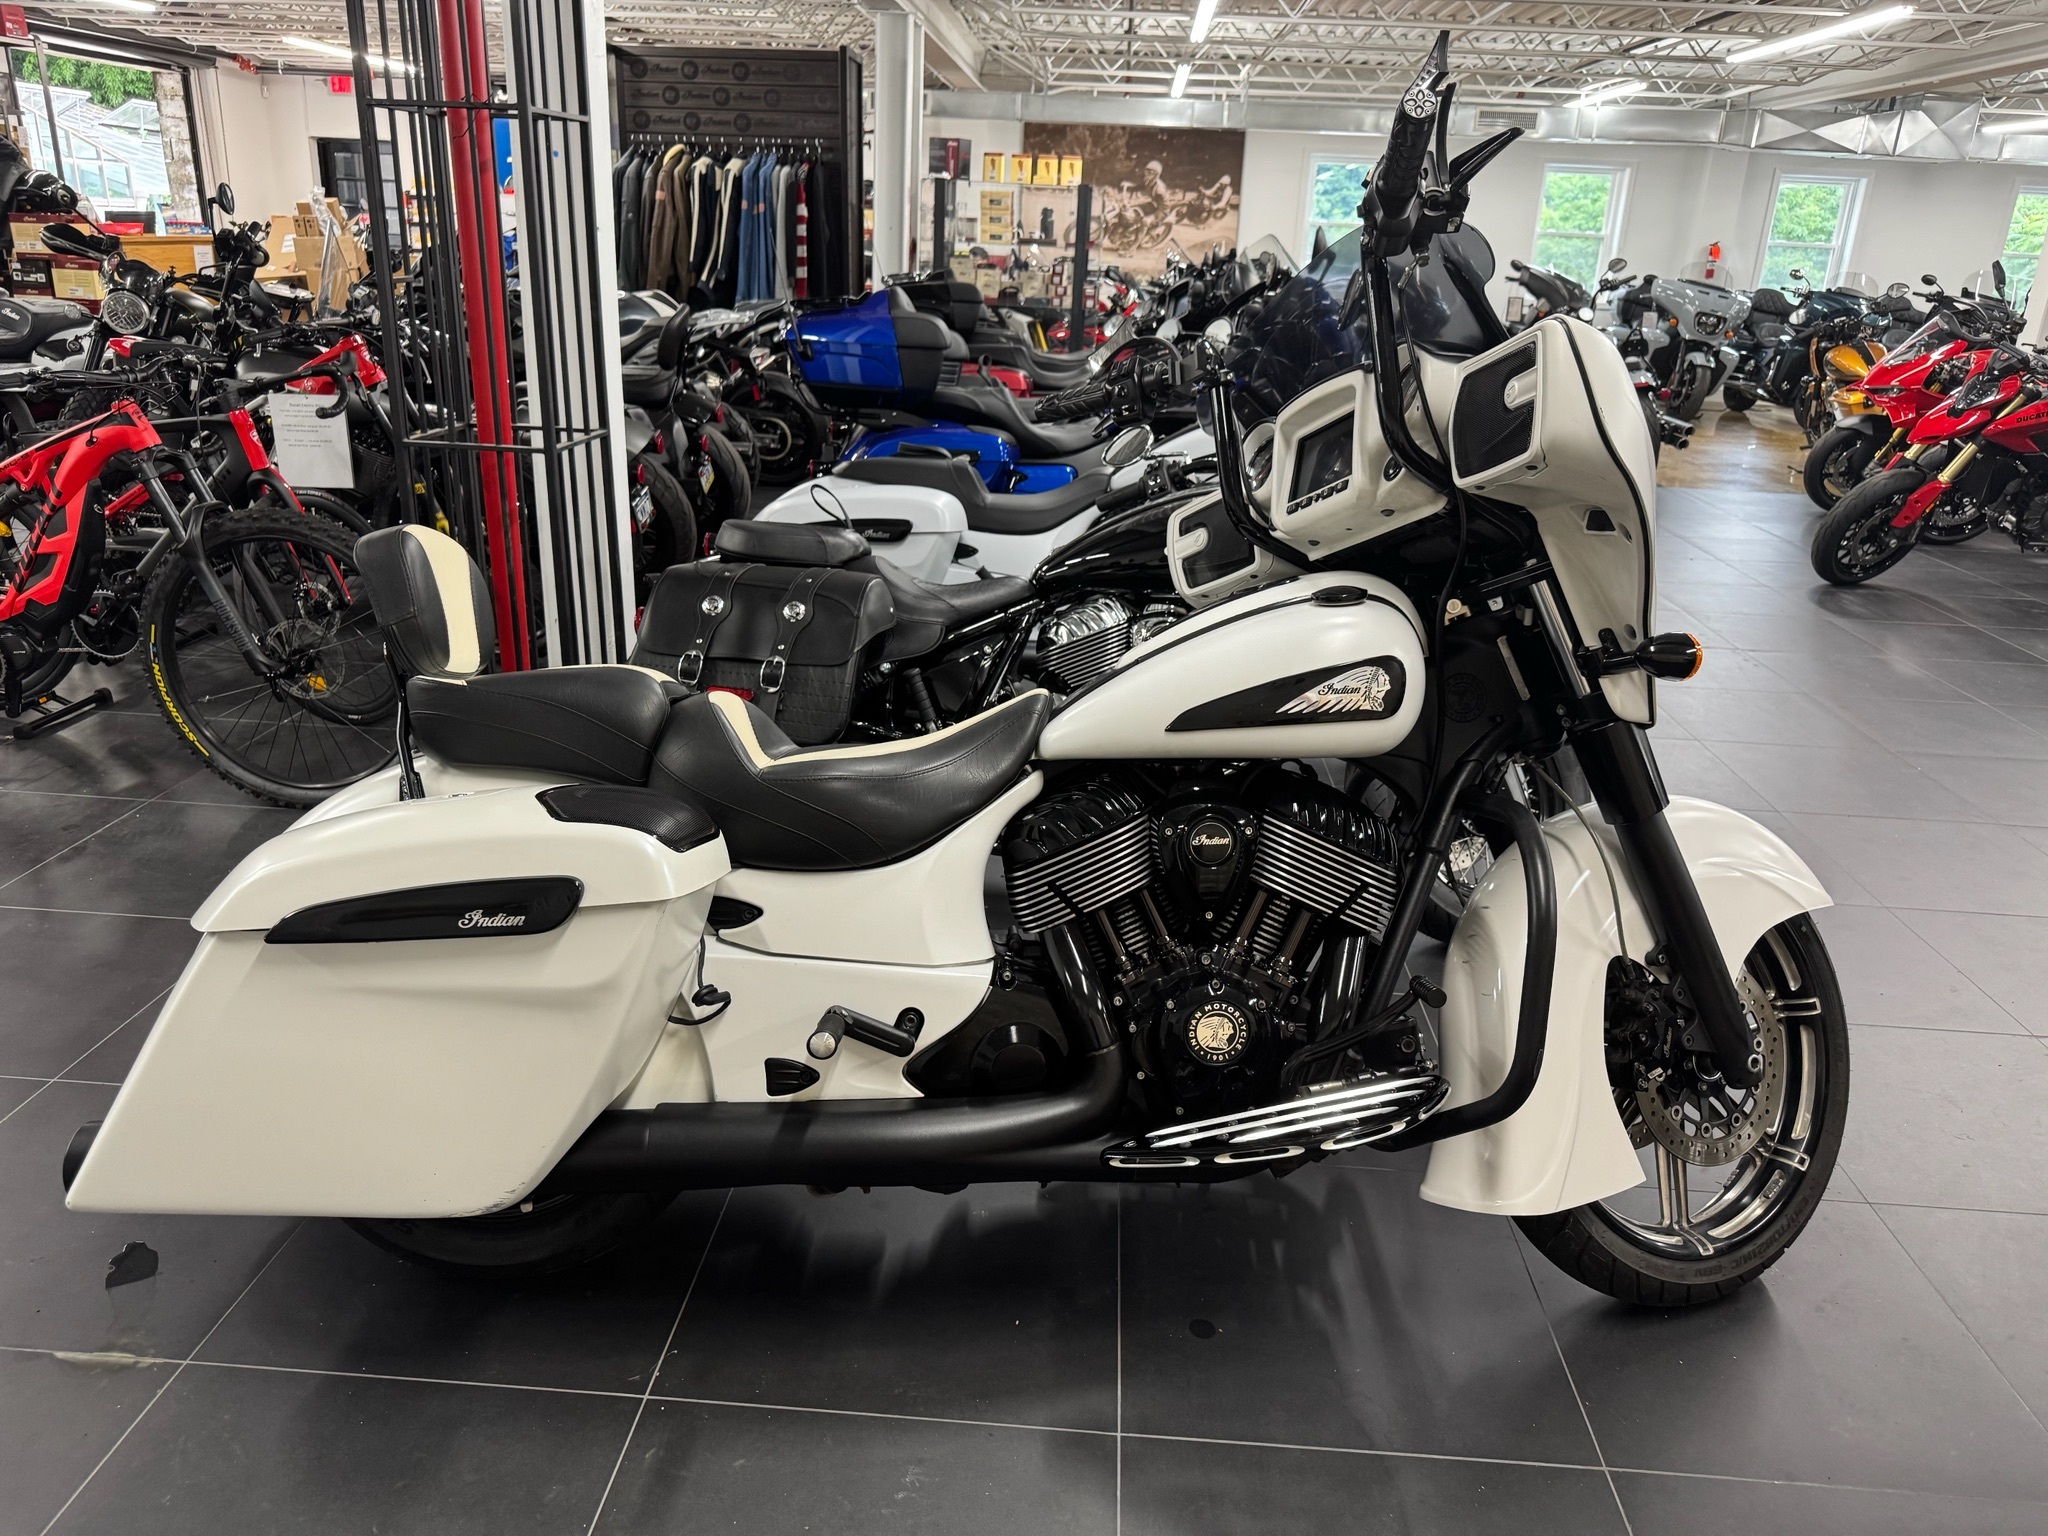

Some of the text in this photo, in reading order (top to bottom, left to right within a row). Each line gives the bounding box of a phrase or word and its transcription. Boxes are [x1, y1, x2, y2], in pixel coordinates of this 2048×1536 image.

[213, 599, 253, 652] ROCKSHOX
[152, 662, 198, 743] SCORPION
[1317, 682, 1361, 696] Indian
[1192, 834, 1230, 846] Indian
[458, 909, 526, 929] Indian
[1188, 1003, 1247, 1062] INDIAN MOTORCYCLE 1901
